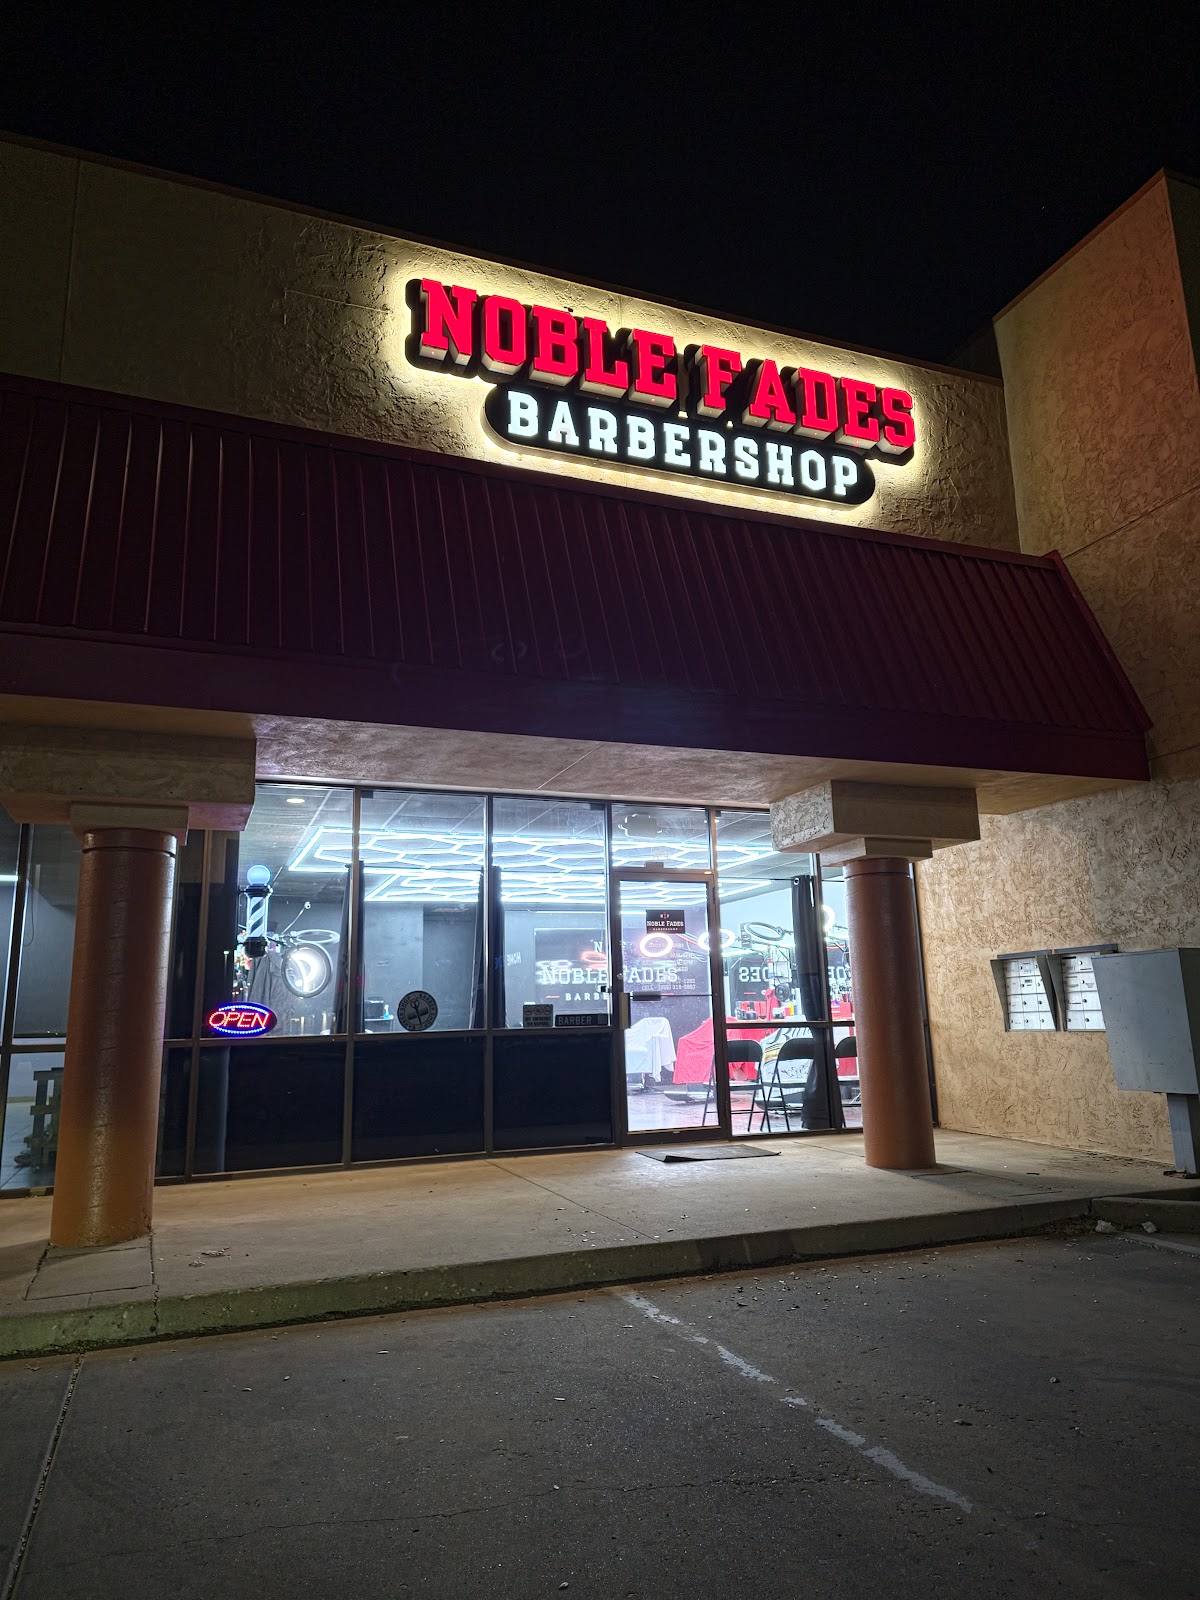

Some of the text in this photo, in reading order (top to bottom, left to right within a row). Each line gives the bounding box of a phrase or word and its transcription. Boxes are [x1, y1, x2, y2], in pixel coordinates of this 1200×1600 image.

[421, 278, 915, 447] NOBLE FADES
[507, 391, 859, 496] BARBERSHOP
[541, 965, 609, 985] NOBLE
[565, 992, 609, 1001] BARBE
[208, 1011, 270, 1028] OPEN
[557, 1015, 592, 1026] BARBER
